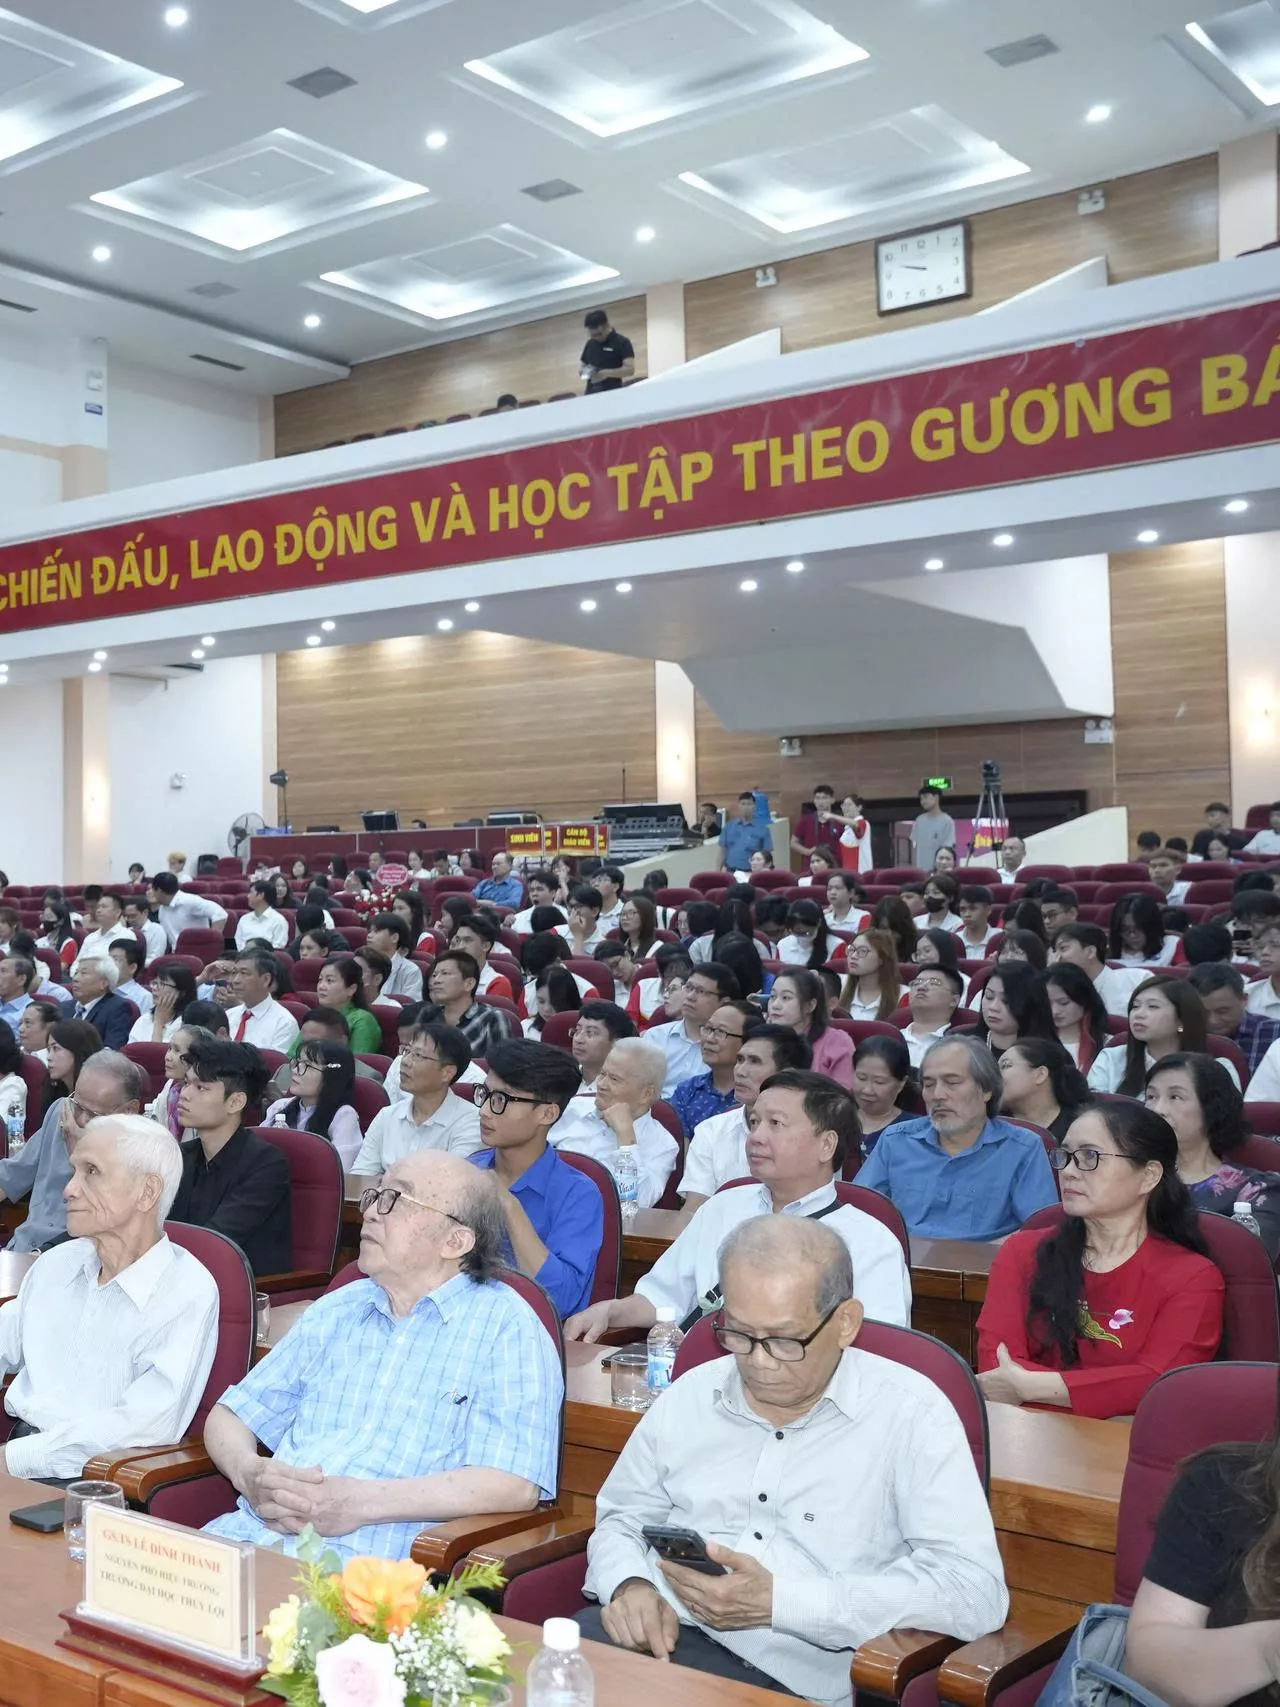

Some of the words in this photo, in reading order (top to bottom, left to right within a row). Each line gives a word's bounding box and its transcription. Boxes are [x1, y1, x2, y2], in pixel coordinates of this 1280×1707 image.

[91, 532, 179, 594] ĐẤU,
[191, 529, 263, 578] LAO
[275, 506, 397, 571] ĐỘNG
[411, 483, 475, 542] VÀ
[489, 472, 590, 538] HỌC
[608, 447, 712, 519] TẬP
[732, 420, 889, 490] THEO
[911, 368, 1171, 461] GƯƠNG
[510, 834, 524, 844] SINH
[524, 832, 538, 843] VIÊN
[578, 838, 590, 846] VIÊN
